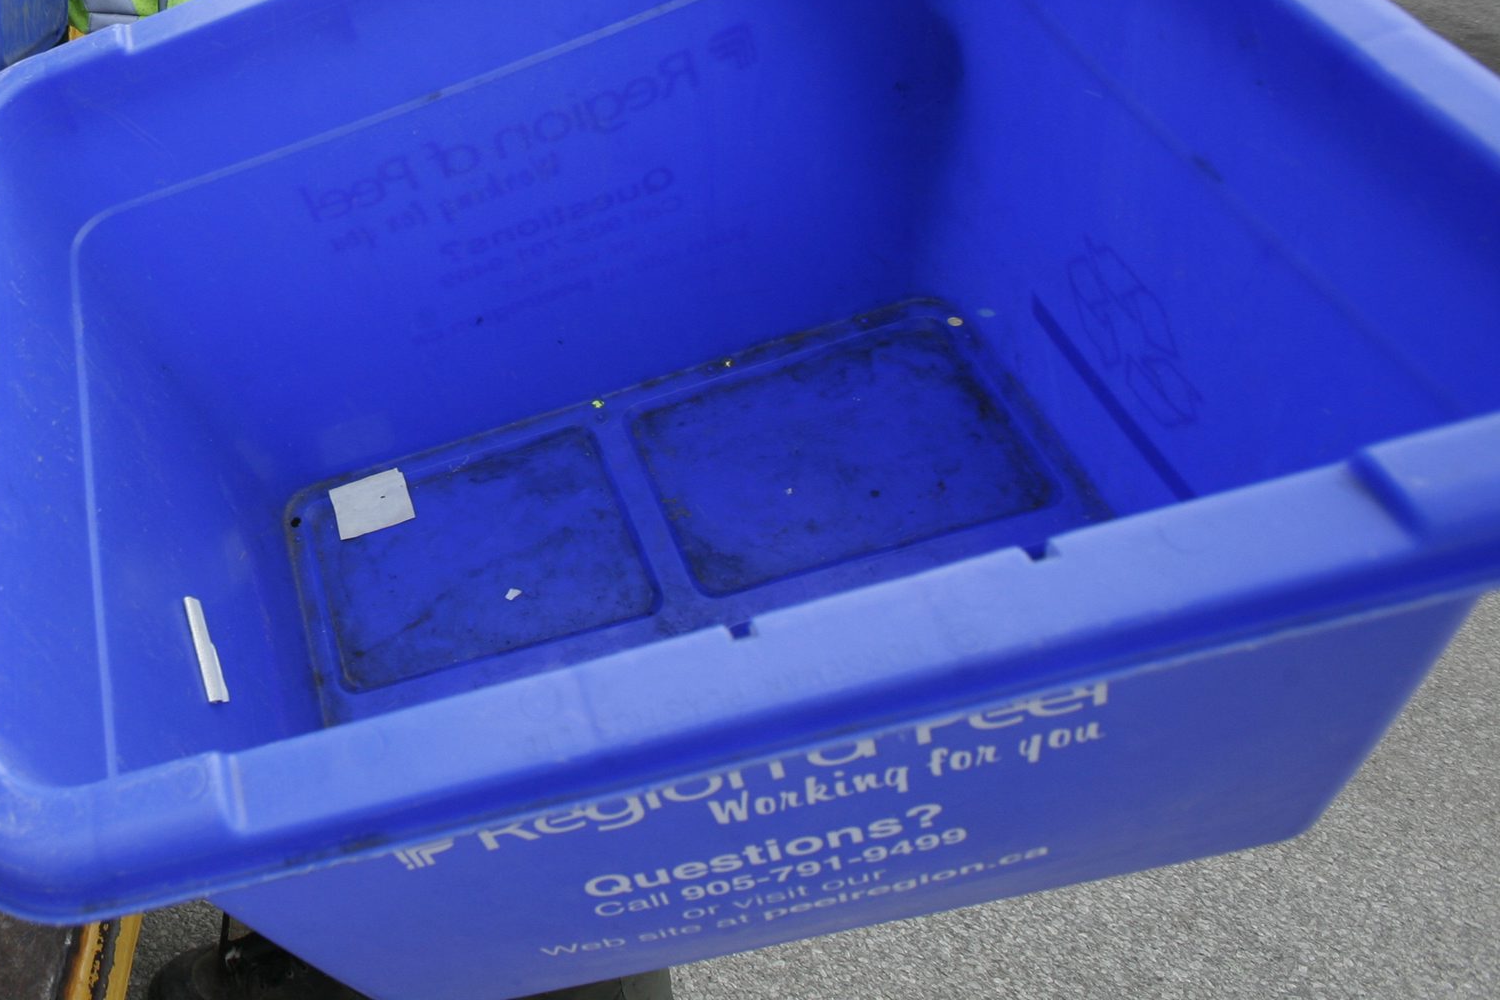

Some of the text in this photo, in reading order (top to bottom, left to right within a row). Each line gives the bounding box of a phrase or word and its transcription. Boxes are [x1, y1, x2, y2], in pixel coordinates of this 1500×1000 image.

[708, 721, 1107, 826] Working for you
[583, 803, 944, 899] Questions?
[592, 826, 969, 919] Call 905-791-9499
[682, 868, 889, 921] or visit our
[539, 847, 1051, 958] Web site at peelregion.ca
